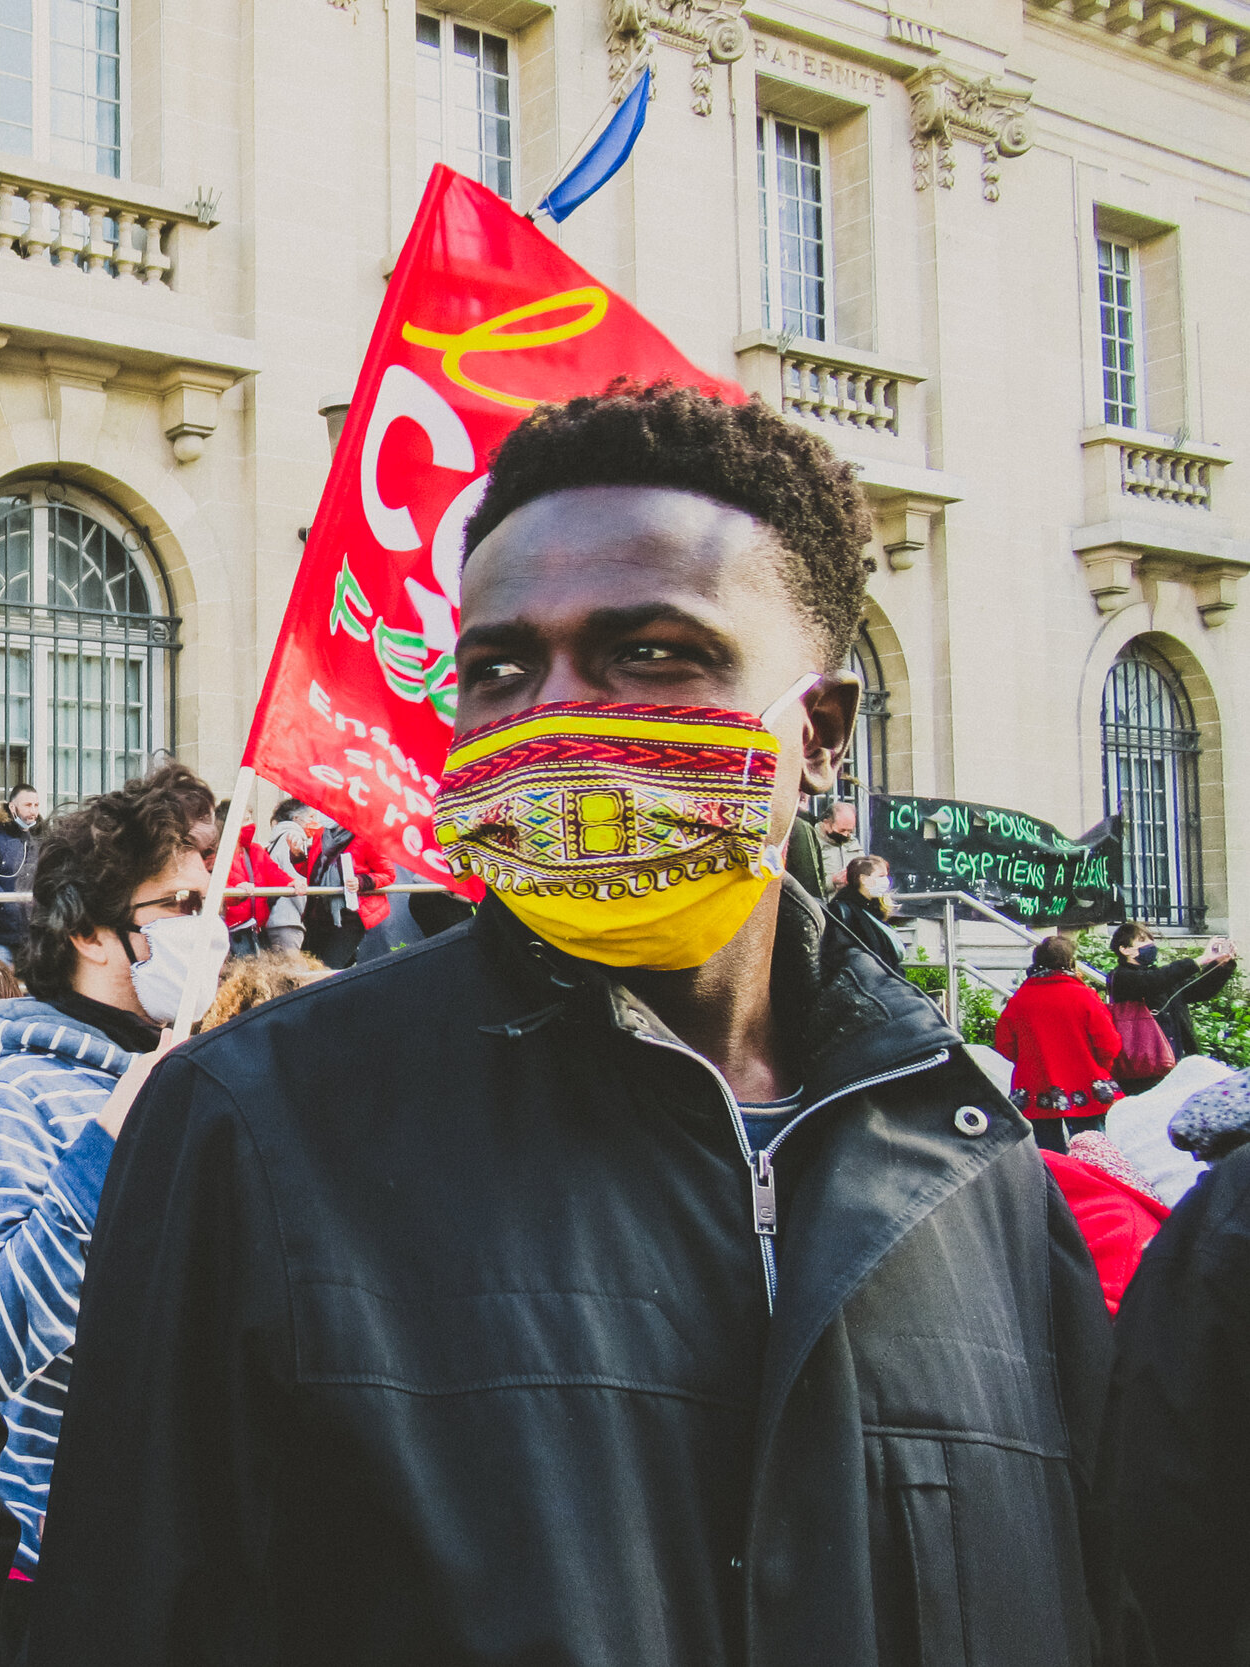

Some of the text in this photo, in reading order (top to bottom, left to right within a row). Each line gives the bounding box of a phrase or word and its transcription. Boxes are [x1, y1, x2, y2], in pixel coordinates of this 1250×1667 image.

[753, 38, 886, 97] RATERNITÉ
[344, 748, 434, 818] sup
[308, 764, 452, 875] et rec
[936, 805, 969, 836] ON
[985, 810, 1042, 843] POUSSE
